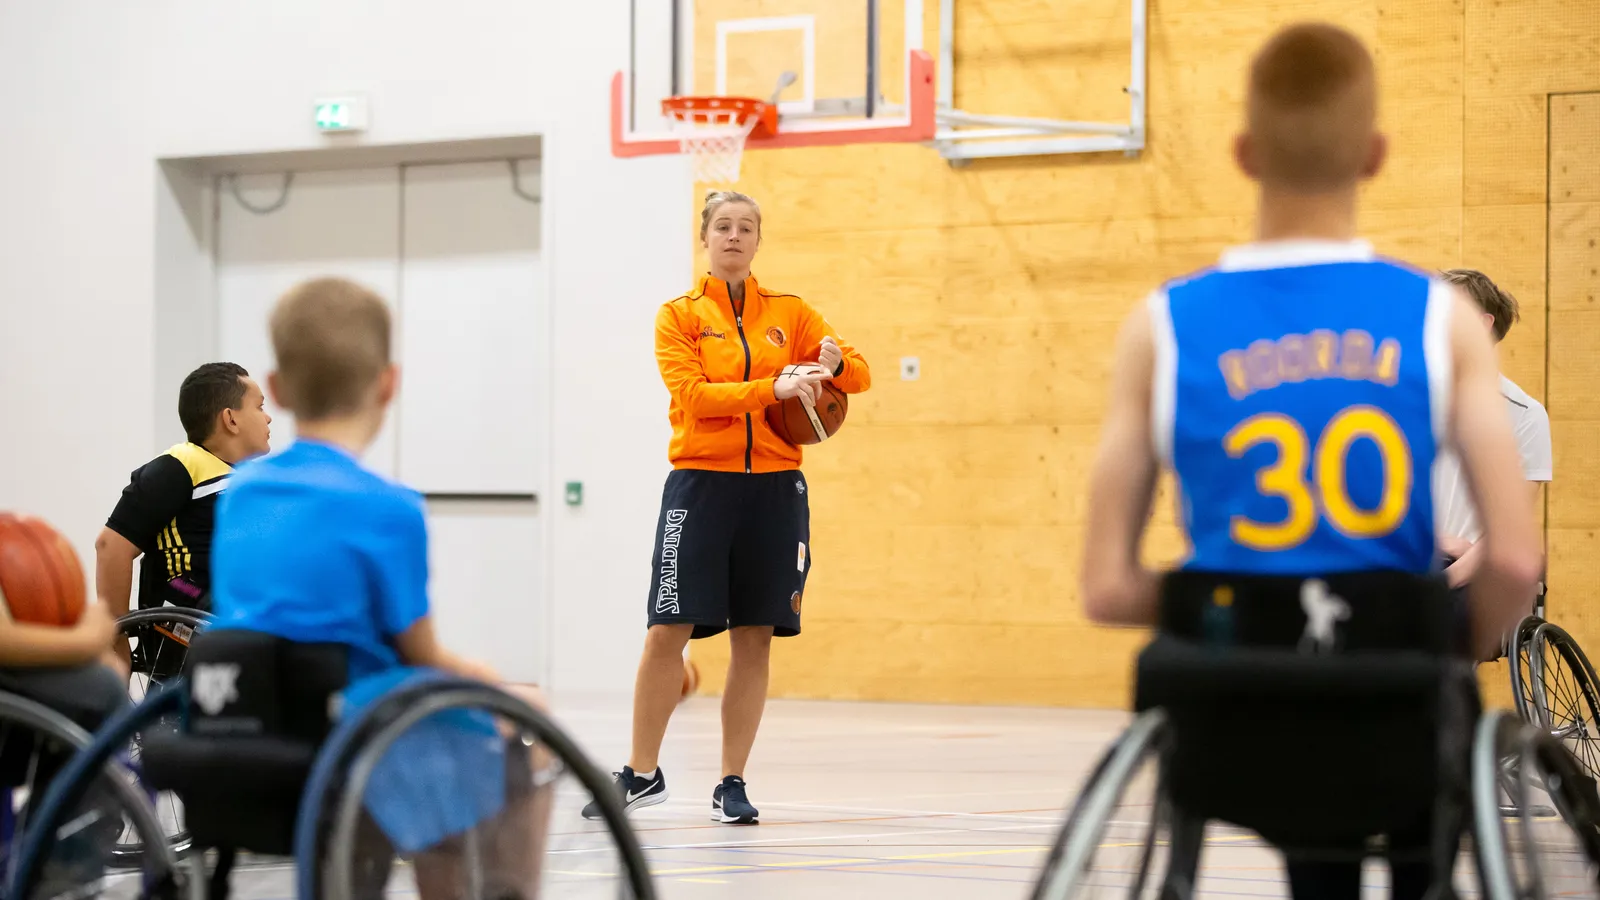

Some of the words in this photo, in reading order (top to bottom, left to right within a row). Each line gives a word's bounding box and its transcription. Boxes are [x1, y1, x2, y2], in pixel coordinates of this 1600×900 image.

[699, 331, 725, 340] PALDING
[1223, 405, 1413, 551] 30
[656, 509, 688, 614] SPALDING
